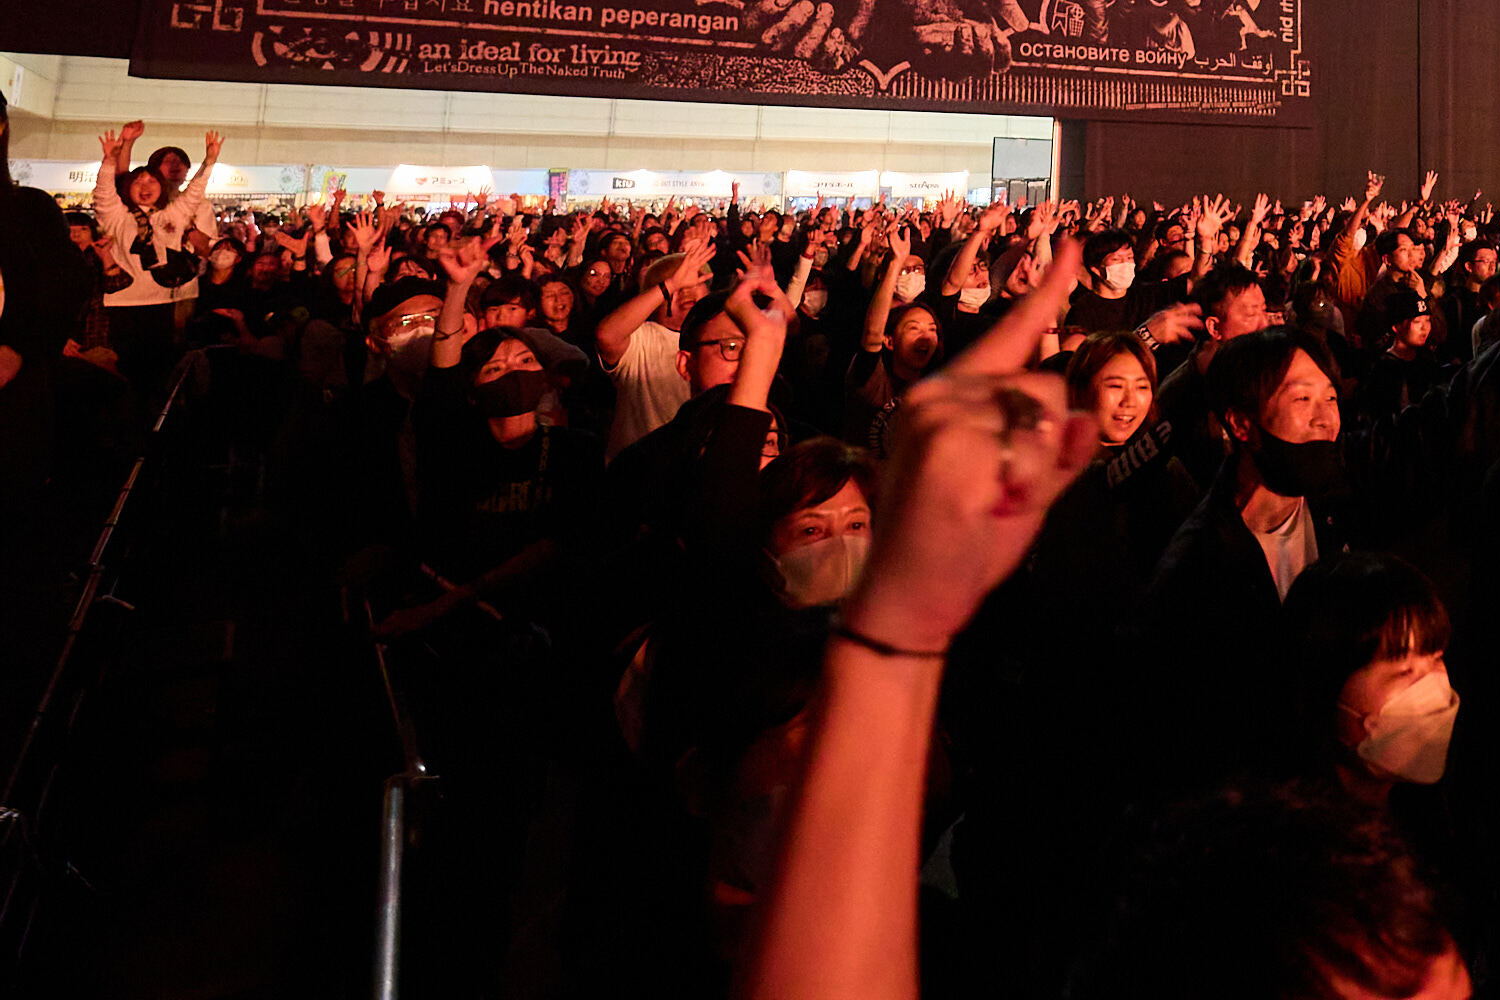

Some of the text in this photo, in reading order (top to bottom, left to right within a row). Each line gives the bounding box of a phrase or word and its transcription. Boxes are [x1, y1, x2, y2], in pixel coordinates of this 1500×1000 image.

[600, 6, 739, 34] peperangan
[1281, 18, 1294, 43] nid
[418, 38, 641, 73] an ideal for living
[1019, 42, 1188, 70] остановите войну
